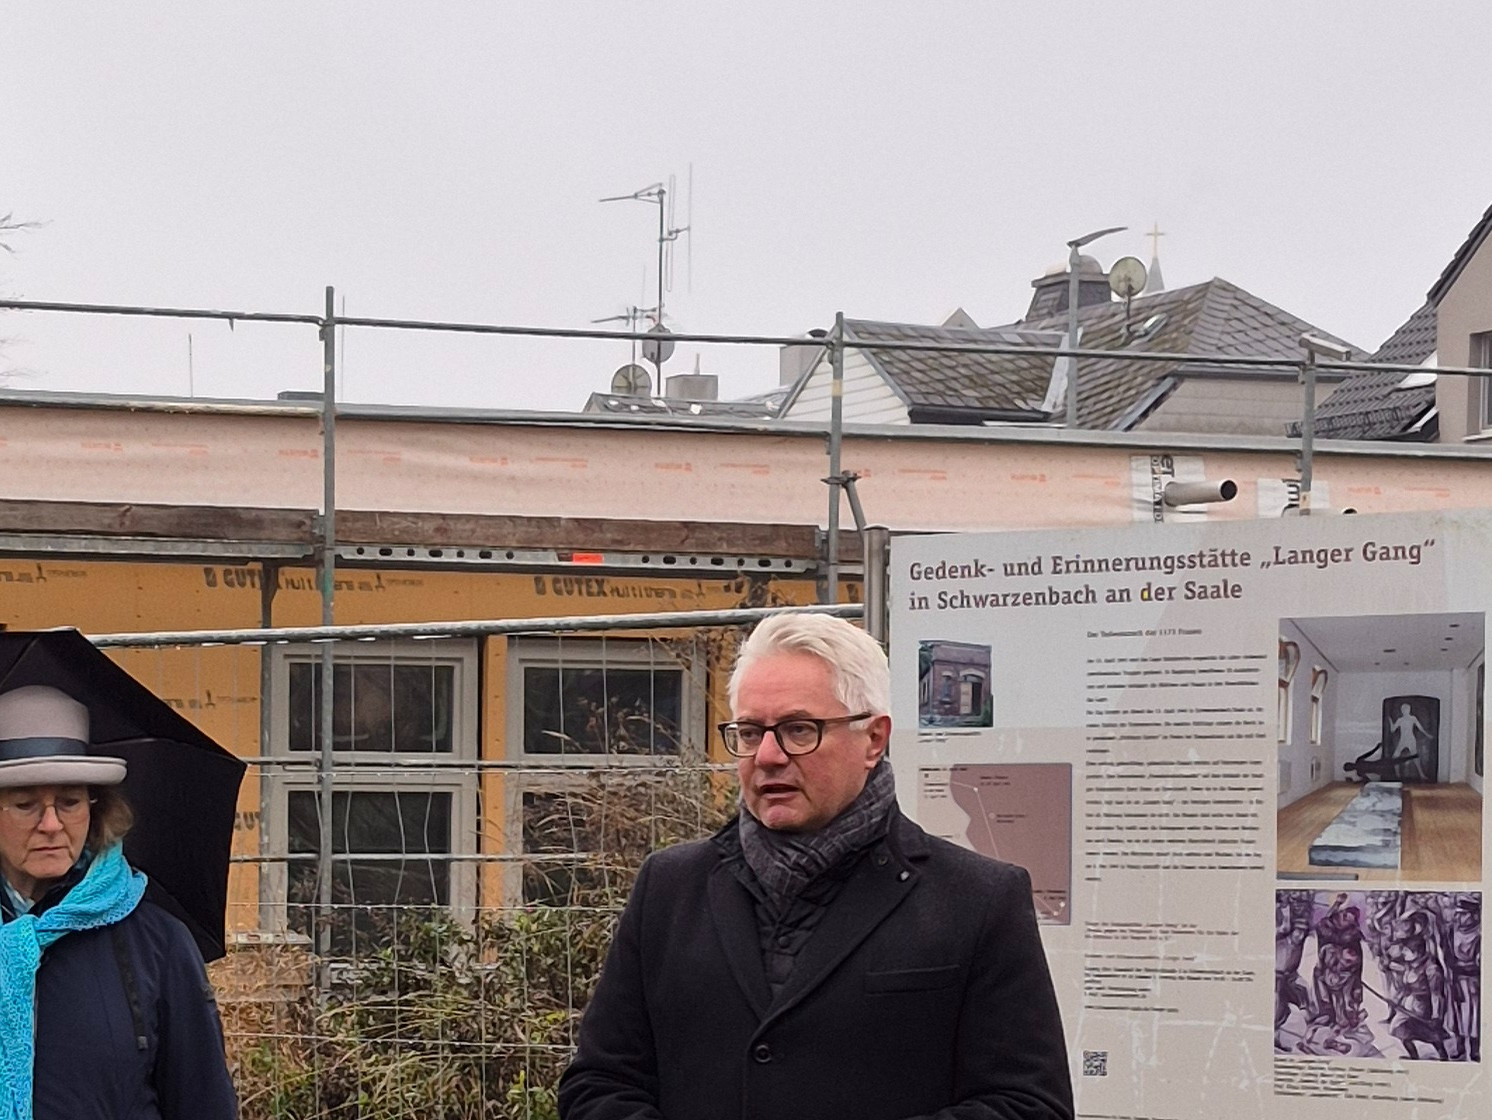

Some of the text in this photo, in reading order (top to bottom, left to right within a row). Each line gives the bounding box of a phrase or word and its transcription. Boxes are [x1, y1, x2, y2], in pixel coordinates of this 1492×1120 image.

[909, 559, 995, 580] Gedenk-
[1002, 556, 1043, 577] und
[1050, 548, 1251, 575] Erinnerungsstätte
[551, 577, 607, 598] GUTEX
[908, 578, 1244, 611] in Schwarzenbach an der Saale
